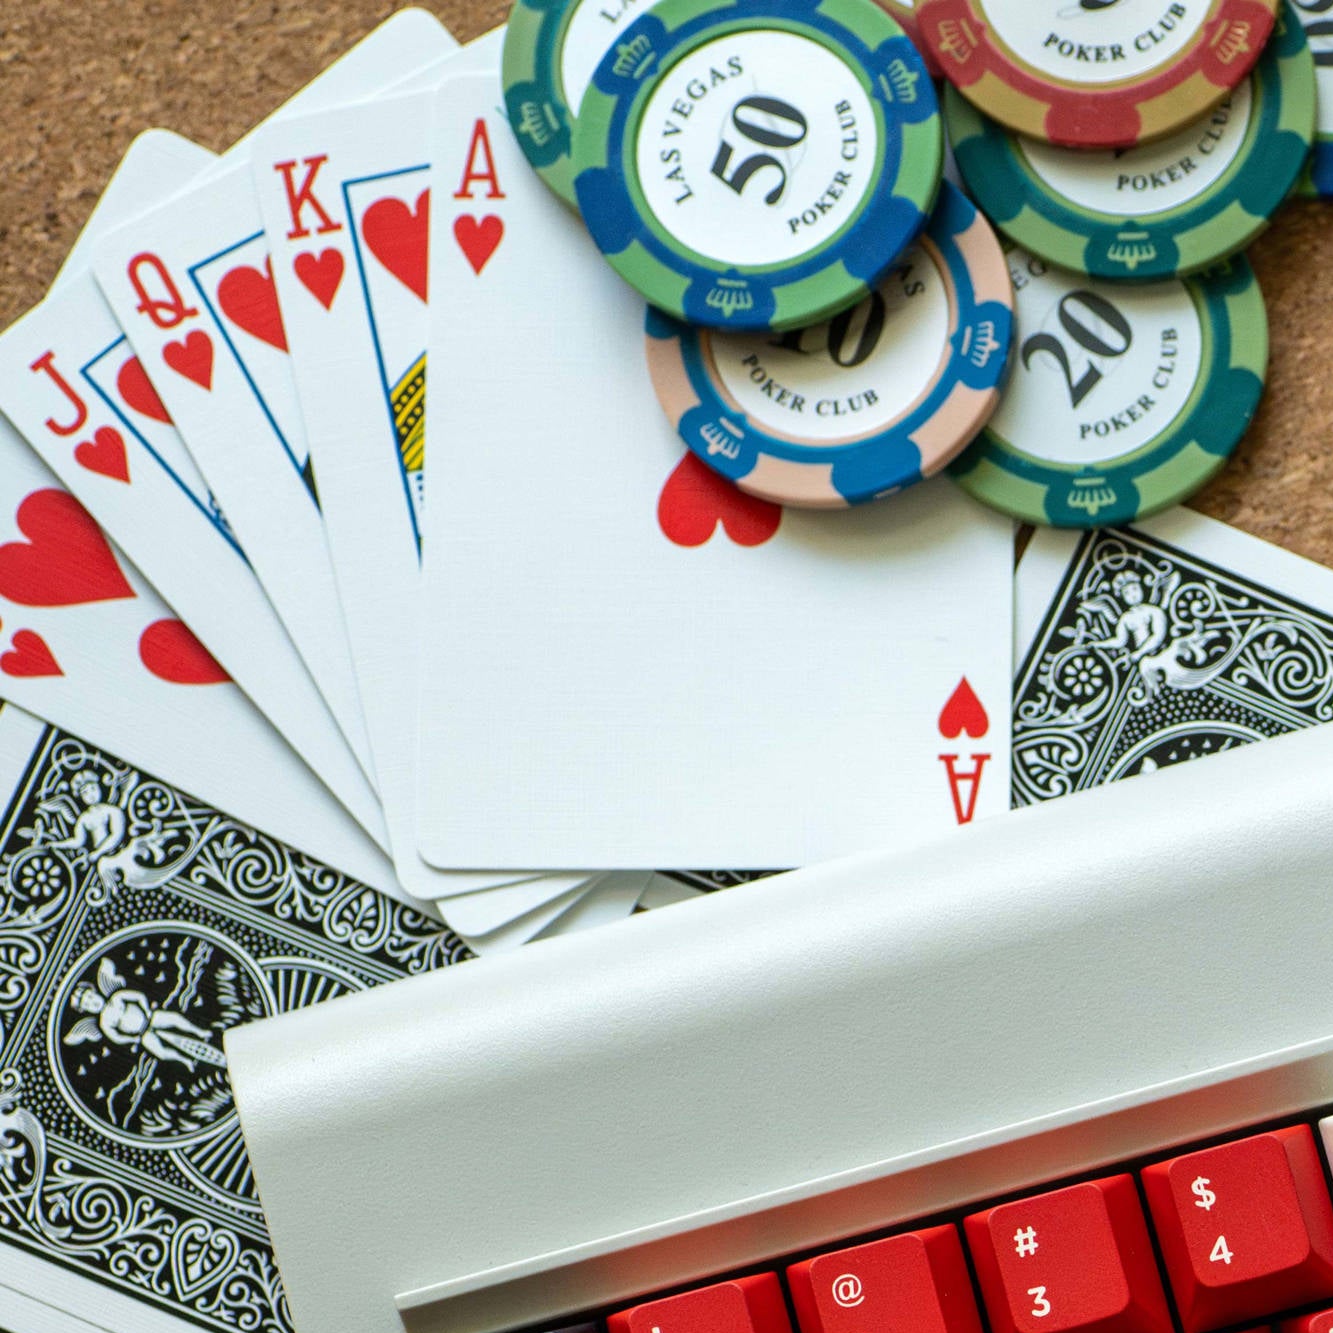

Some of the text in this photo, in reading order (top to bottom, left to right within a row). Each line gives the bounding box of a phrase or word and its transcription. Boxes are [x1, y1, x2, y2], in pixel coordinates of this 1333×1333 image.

[1044, 3, 1187, 63] POKER CLUB
[452, 118, 505, 199] A
[660, 55, 744, 206] LAS VEGAS
[711, 94, 808, 206] 50
[787, 99, 859, 235] POKER CLUB
[274, 154, 343, 241] K
[1116, 156, 1197, 192] POKER
[127, 252, 198, 329] Q
[742, 353, 880, 417] POKER CLUB
[1021, 290, 1132, 409] 20
[1080, 327, 1178, 440] POKER CLUB
[30, 351, 90, 436] J
[938, 754, 991, 825] A
[1192, 1176, 1216, 1211] $
[1013, 1225, 1039, 1257] #
[1209, 1236, 1234, 1265] 4
[832, 1273, 865, 1307] @
[1027, 1286, 1051, 1317] 3
